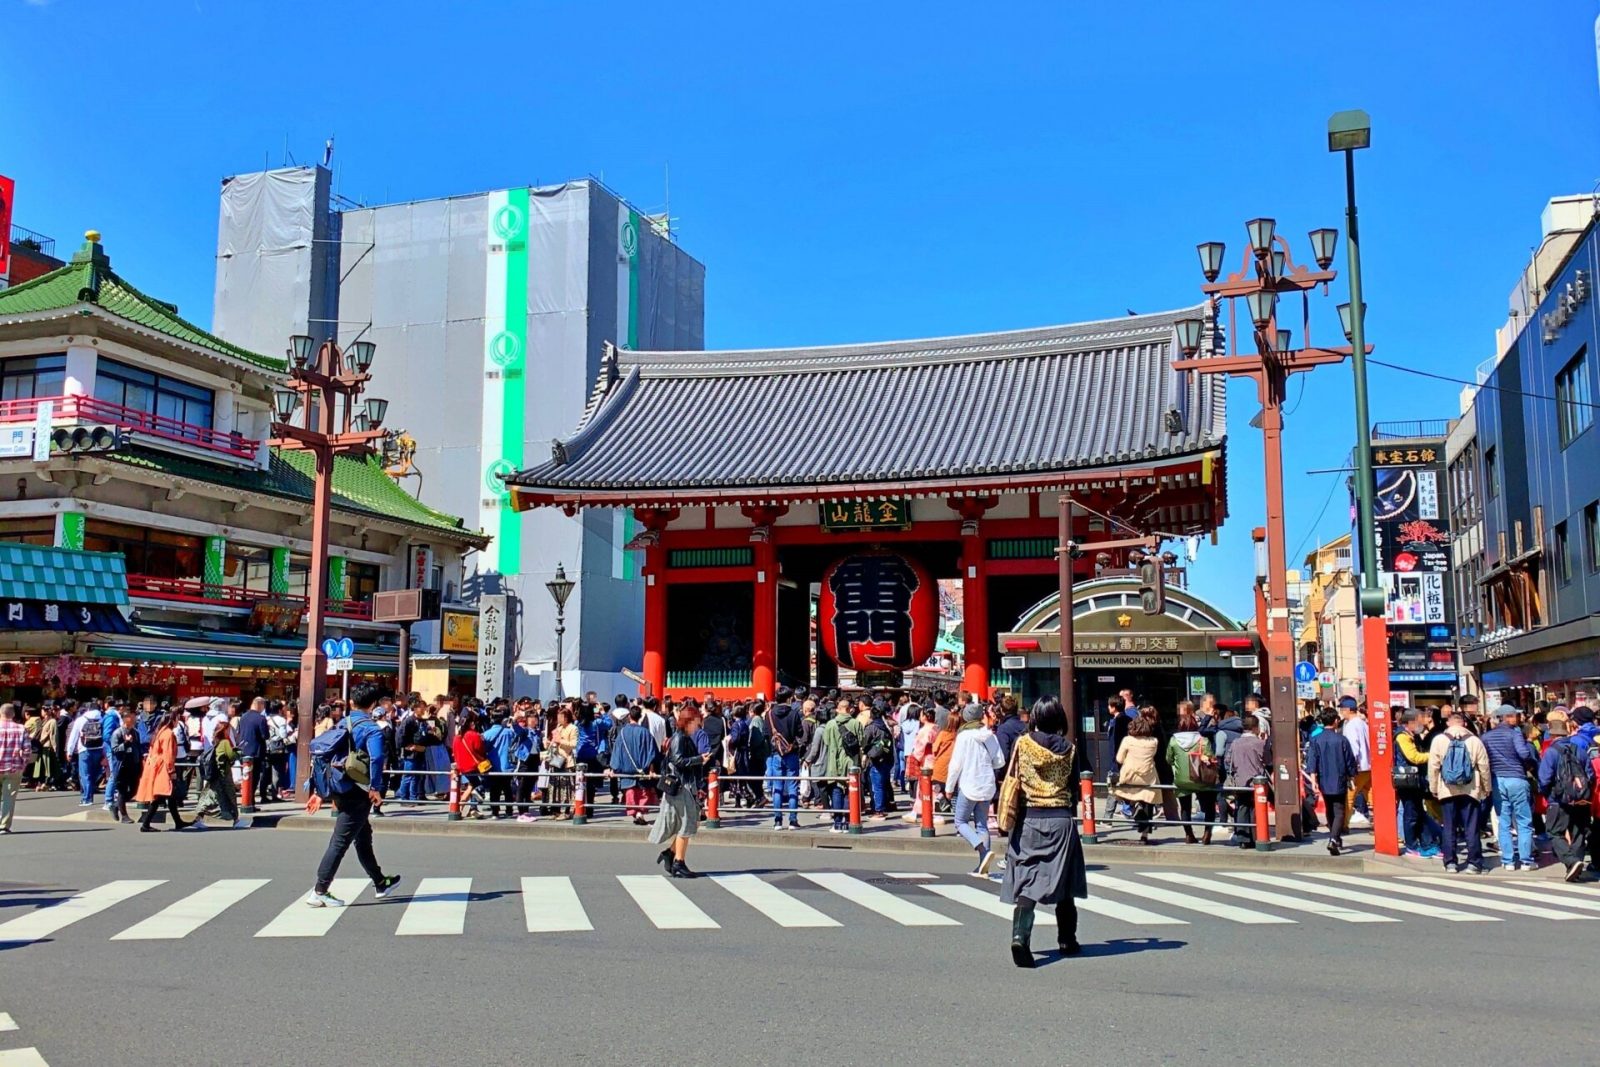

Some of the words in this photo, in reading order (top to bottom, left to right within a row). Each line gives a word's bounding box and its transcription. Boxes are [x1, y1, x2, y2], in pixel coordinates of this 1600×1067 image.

[1426, 575, 1442, 621] 化粧品
[1119, 637, 1179, 650] 雷門交番
[1082, 657, 1141, 665] KAMINARIMON
[1145, 657, 1174, 665] KOBAN
